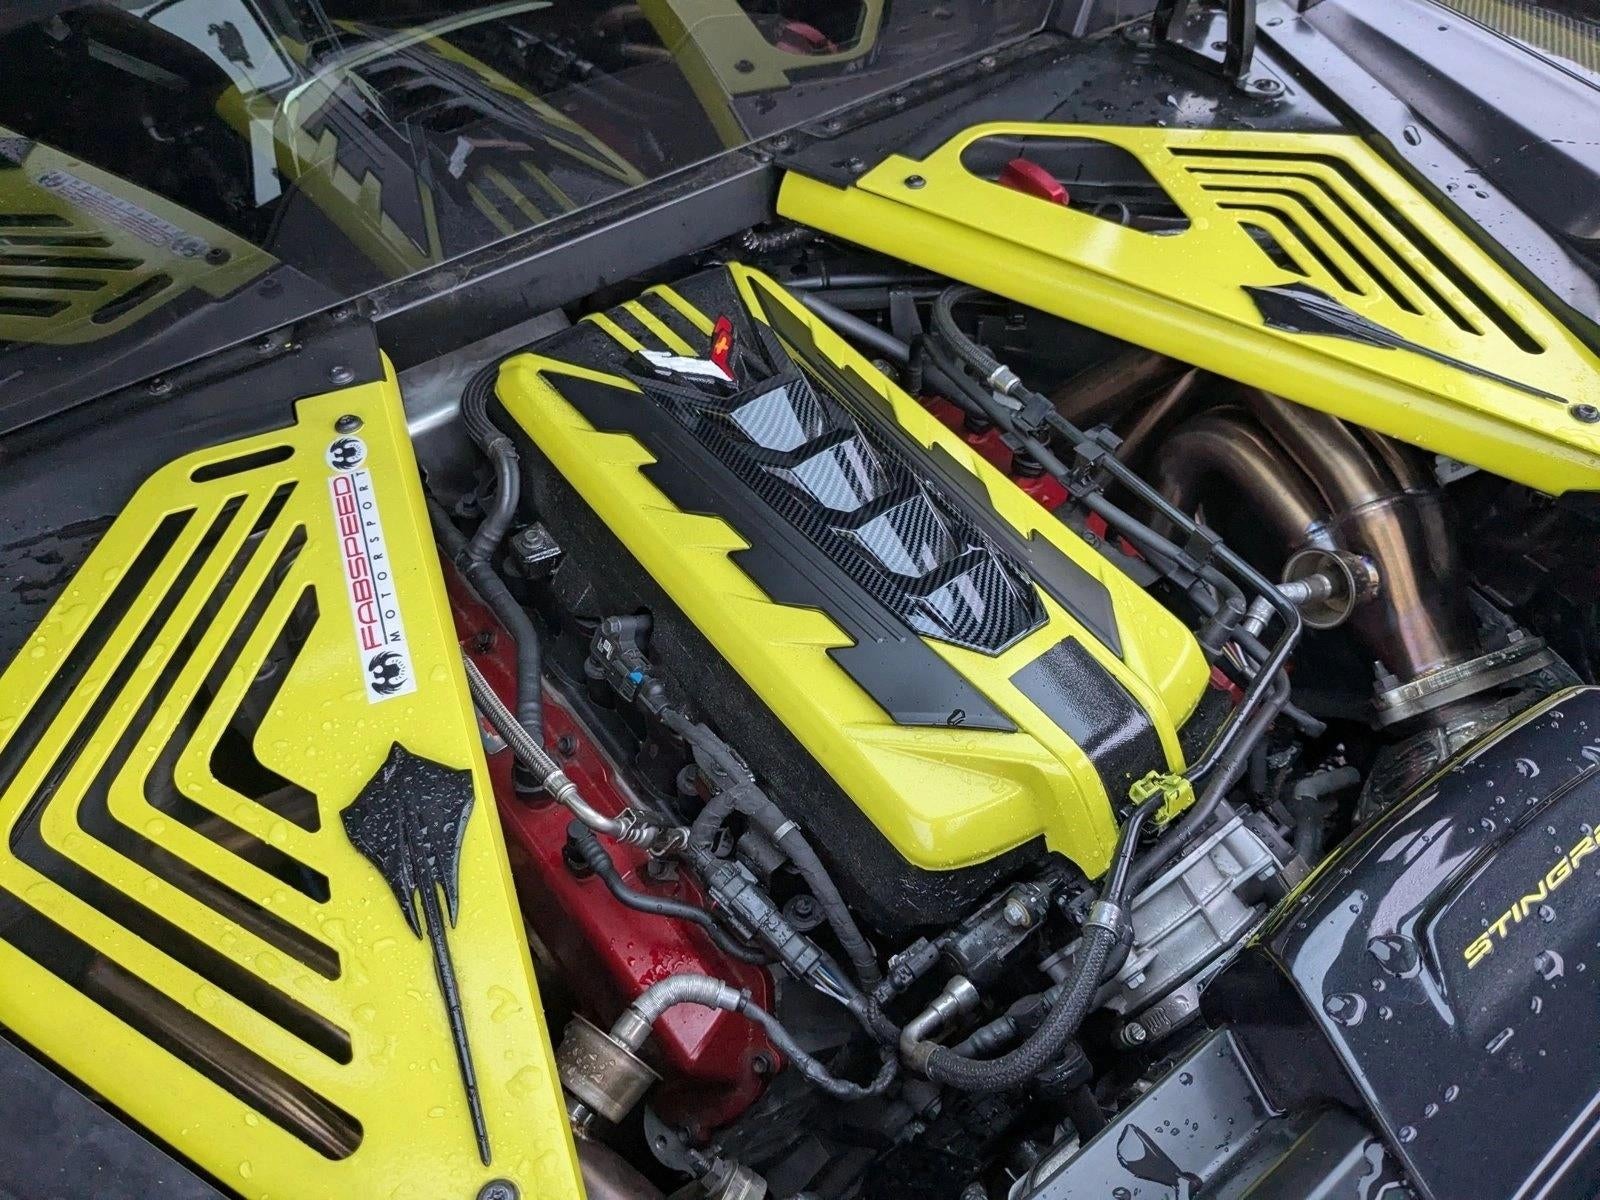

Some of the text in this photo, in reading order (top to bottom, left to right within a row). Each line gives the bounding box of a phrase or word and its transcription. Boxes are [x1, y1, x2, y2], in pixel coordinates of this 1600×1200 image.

[333, 476, 382, 651] FABSPEED
[356, 471, 401, 642] MOTORSPORT
[1464, 823, 1600, 969] STINGR
